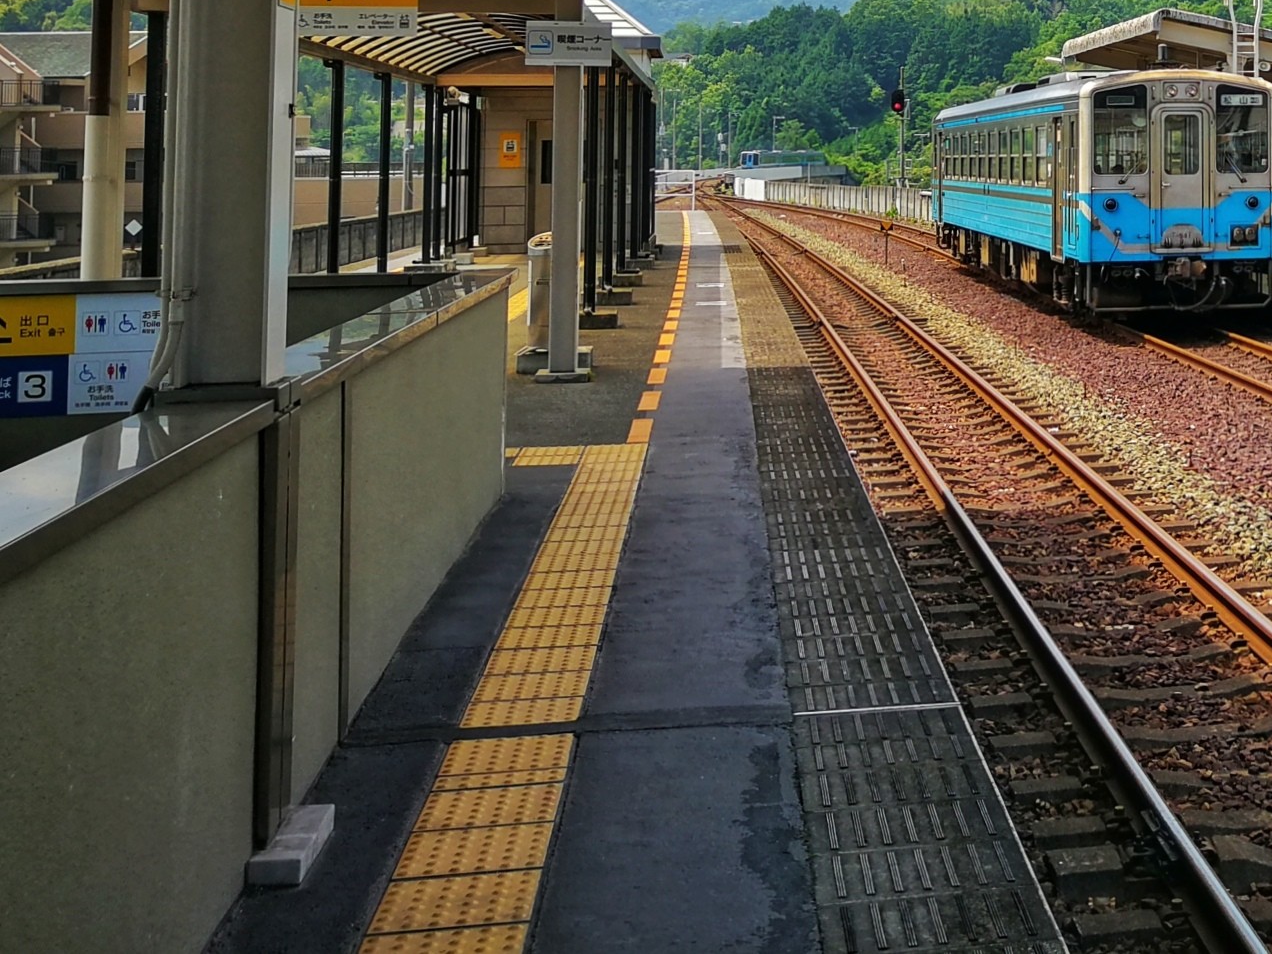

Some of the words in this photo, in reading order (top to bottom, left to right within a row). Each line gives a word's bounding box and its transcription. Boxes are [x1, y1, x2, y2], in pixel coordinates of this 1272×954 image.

[142, 310, 160, 319] お手
[20, 314, 49, 327] 出口
[20, 328, 41, 338] Exit
[24, 374, 46, 399] 3
